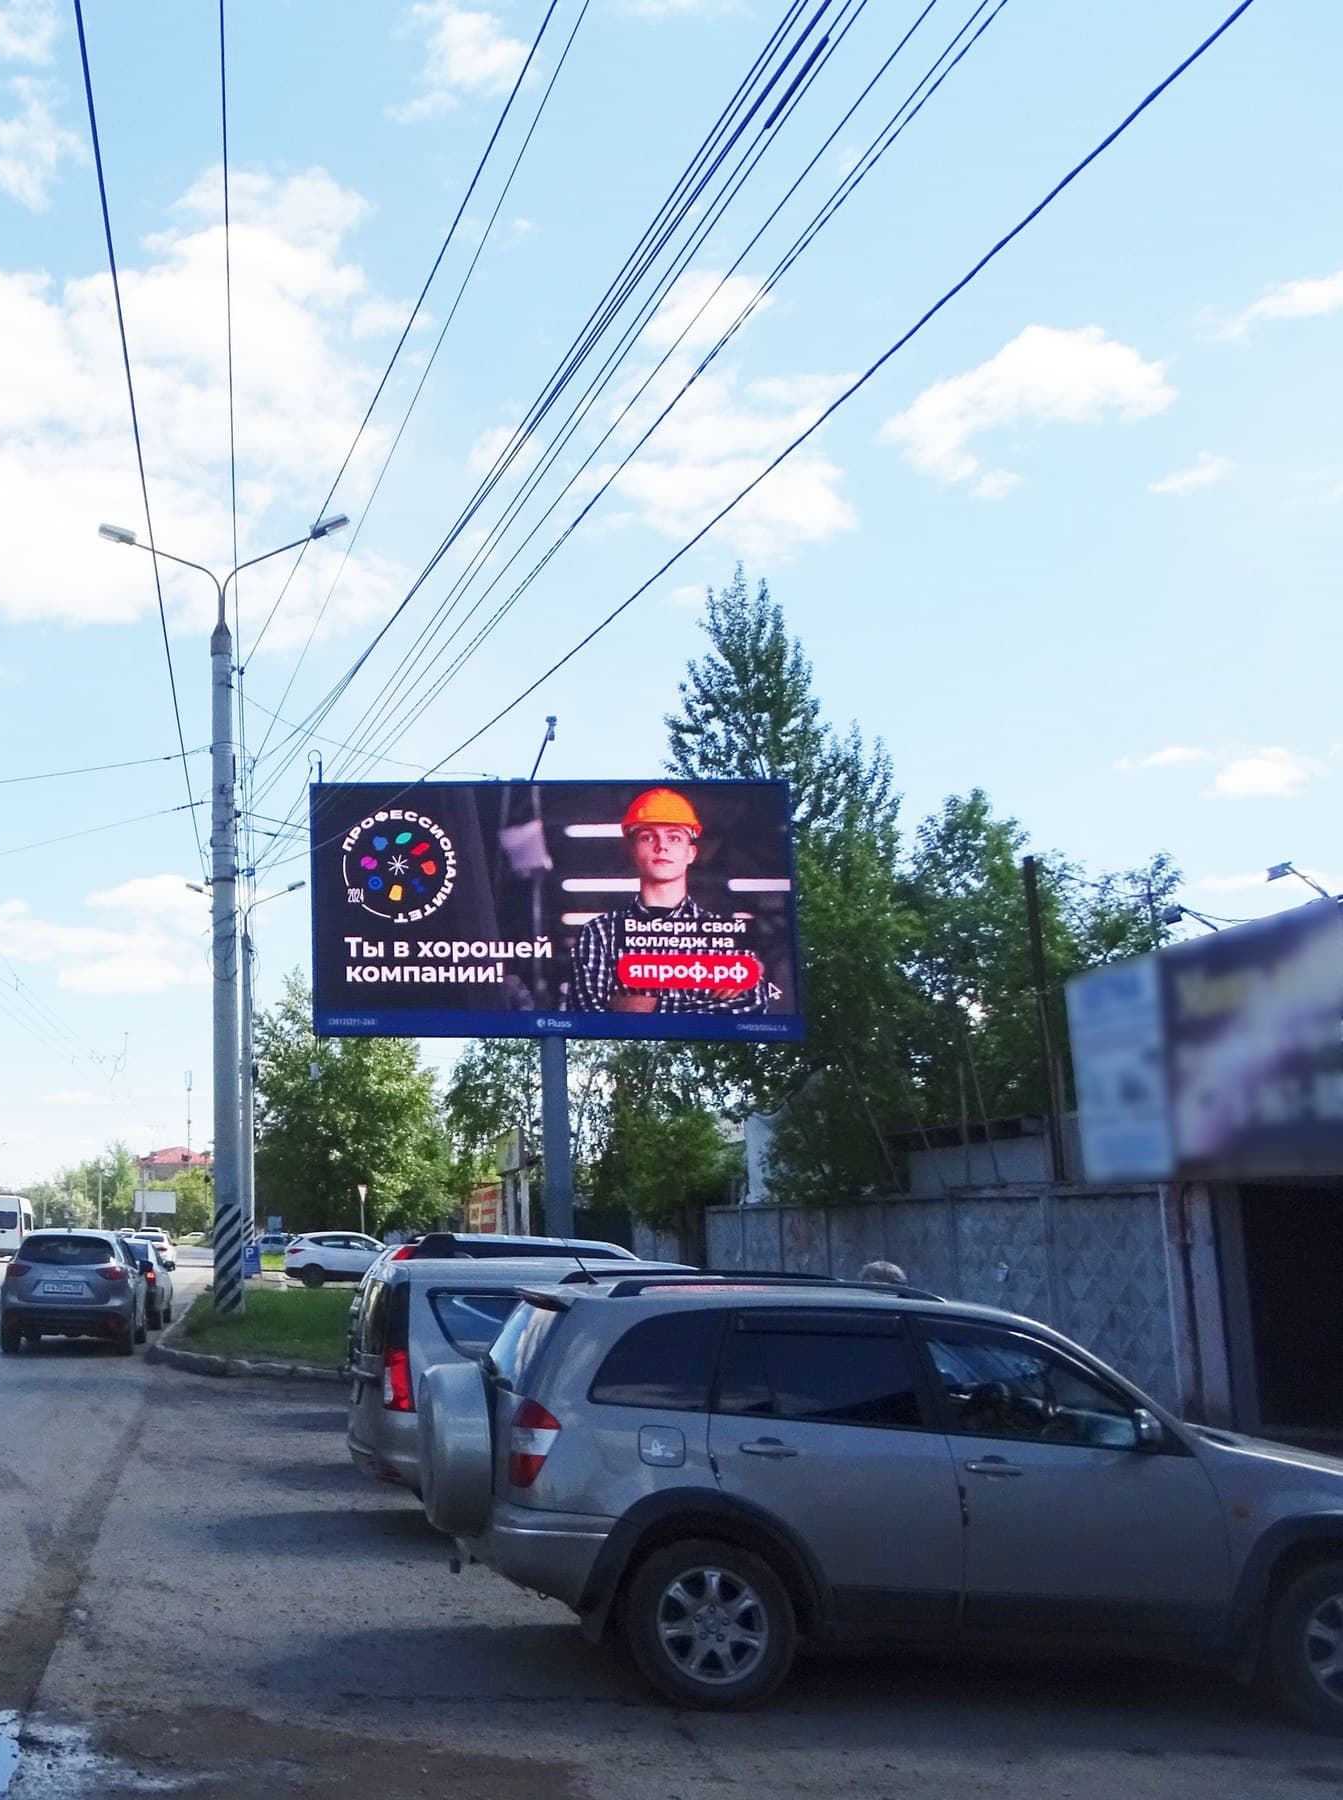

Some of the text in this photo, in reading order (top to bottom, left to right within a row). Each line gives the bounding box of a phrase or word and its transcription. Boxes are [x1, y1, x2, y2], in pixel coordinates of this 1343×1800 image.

[342, 809, 457, 923] ПРОФЕССИОНАЛИТЕТ
[347, 887, 365, 903] 2024
[624, 918, 746, 935] Выбери свой
[344, 935, 553, 963] Ты в хорошей
[625, 936, 735, 949] колледж на
[346, 962, 505, 984] компании!
[628, 961, 749, 984] япроф.рф
